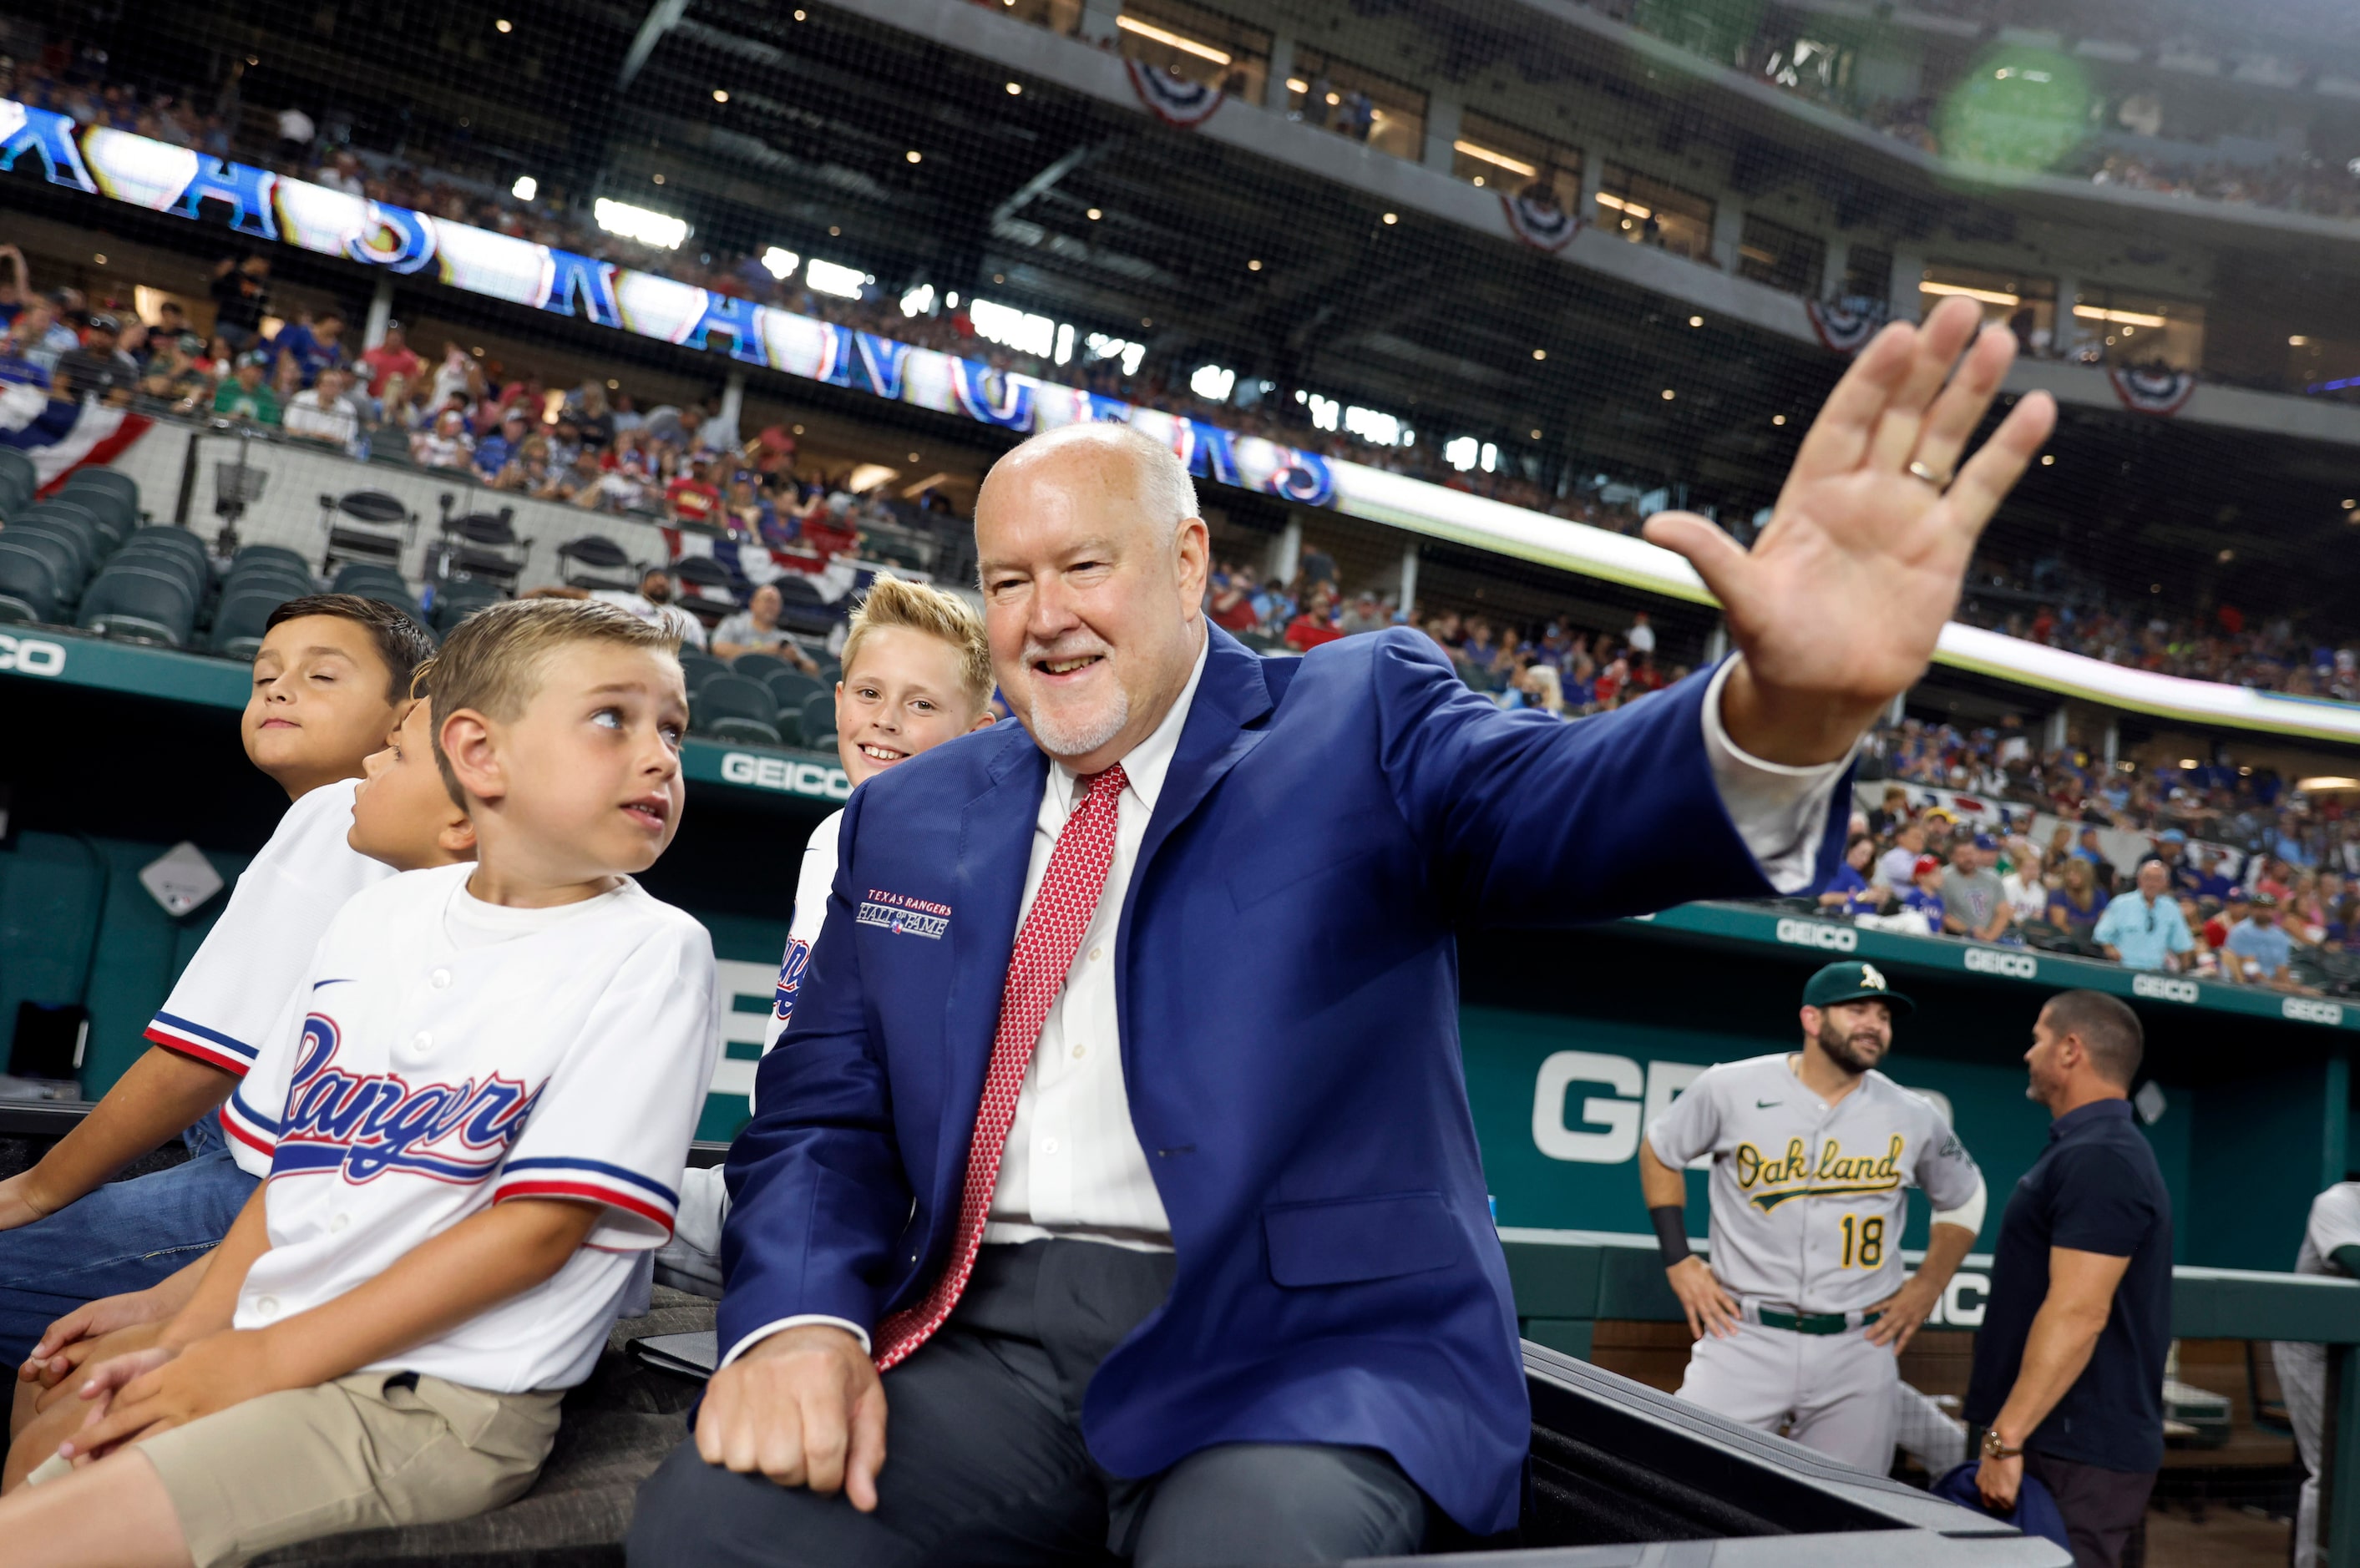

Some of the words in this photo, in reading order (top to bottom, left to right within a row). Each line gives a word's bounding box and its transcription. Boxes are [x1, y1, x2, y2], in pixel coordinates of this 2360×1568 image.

[721, 751, 856, 800] GEICO
[868, 888, 904, 905] TEXAS
[904, 897, 952, 917] RANGERS
[856, 904, 894, 924] HALL
[896, 911, 907, 920] OF
[904, 914, 948, 936] FAME
[1776, 918, 1858, 953] GEICO
[1964, 947, 2038, 980] GEICO
[2132, 973, 2199, 1004] GEICO
[2282, 996, 2343, 1026] GEICO
[1735, 1133, 1905, 1192] Oakland
[1840, 1212, 1885, 1270] 18
